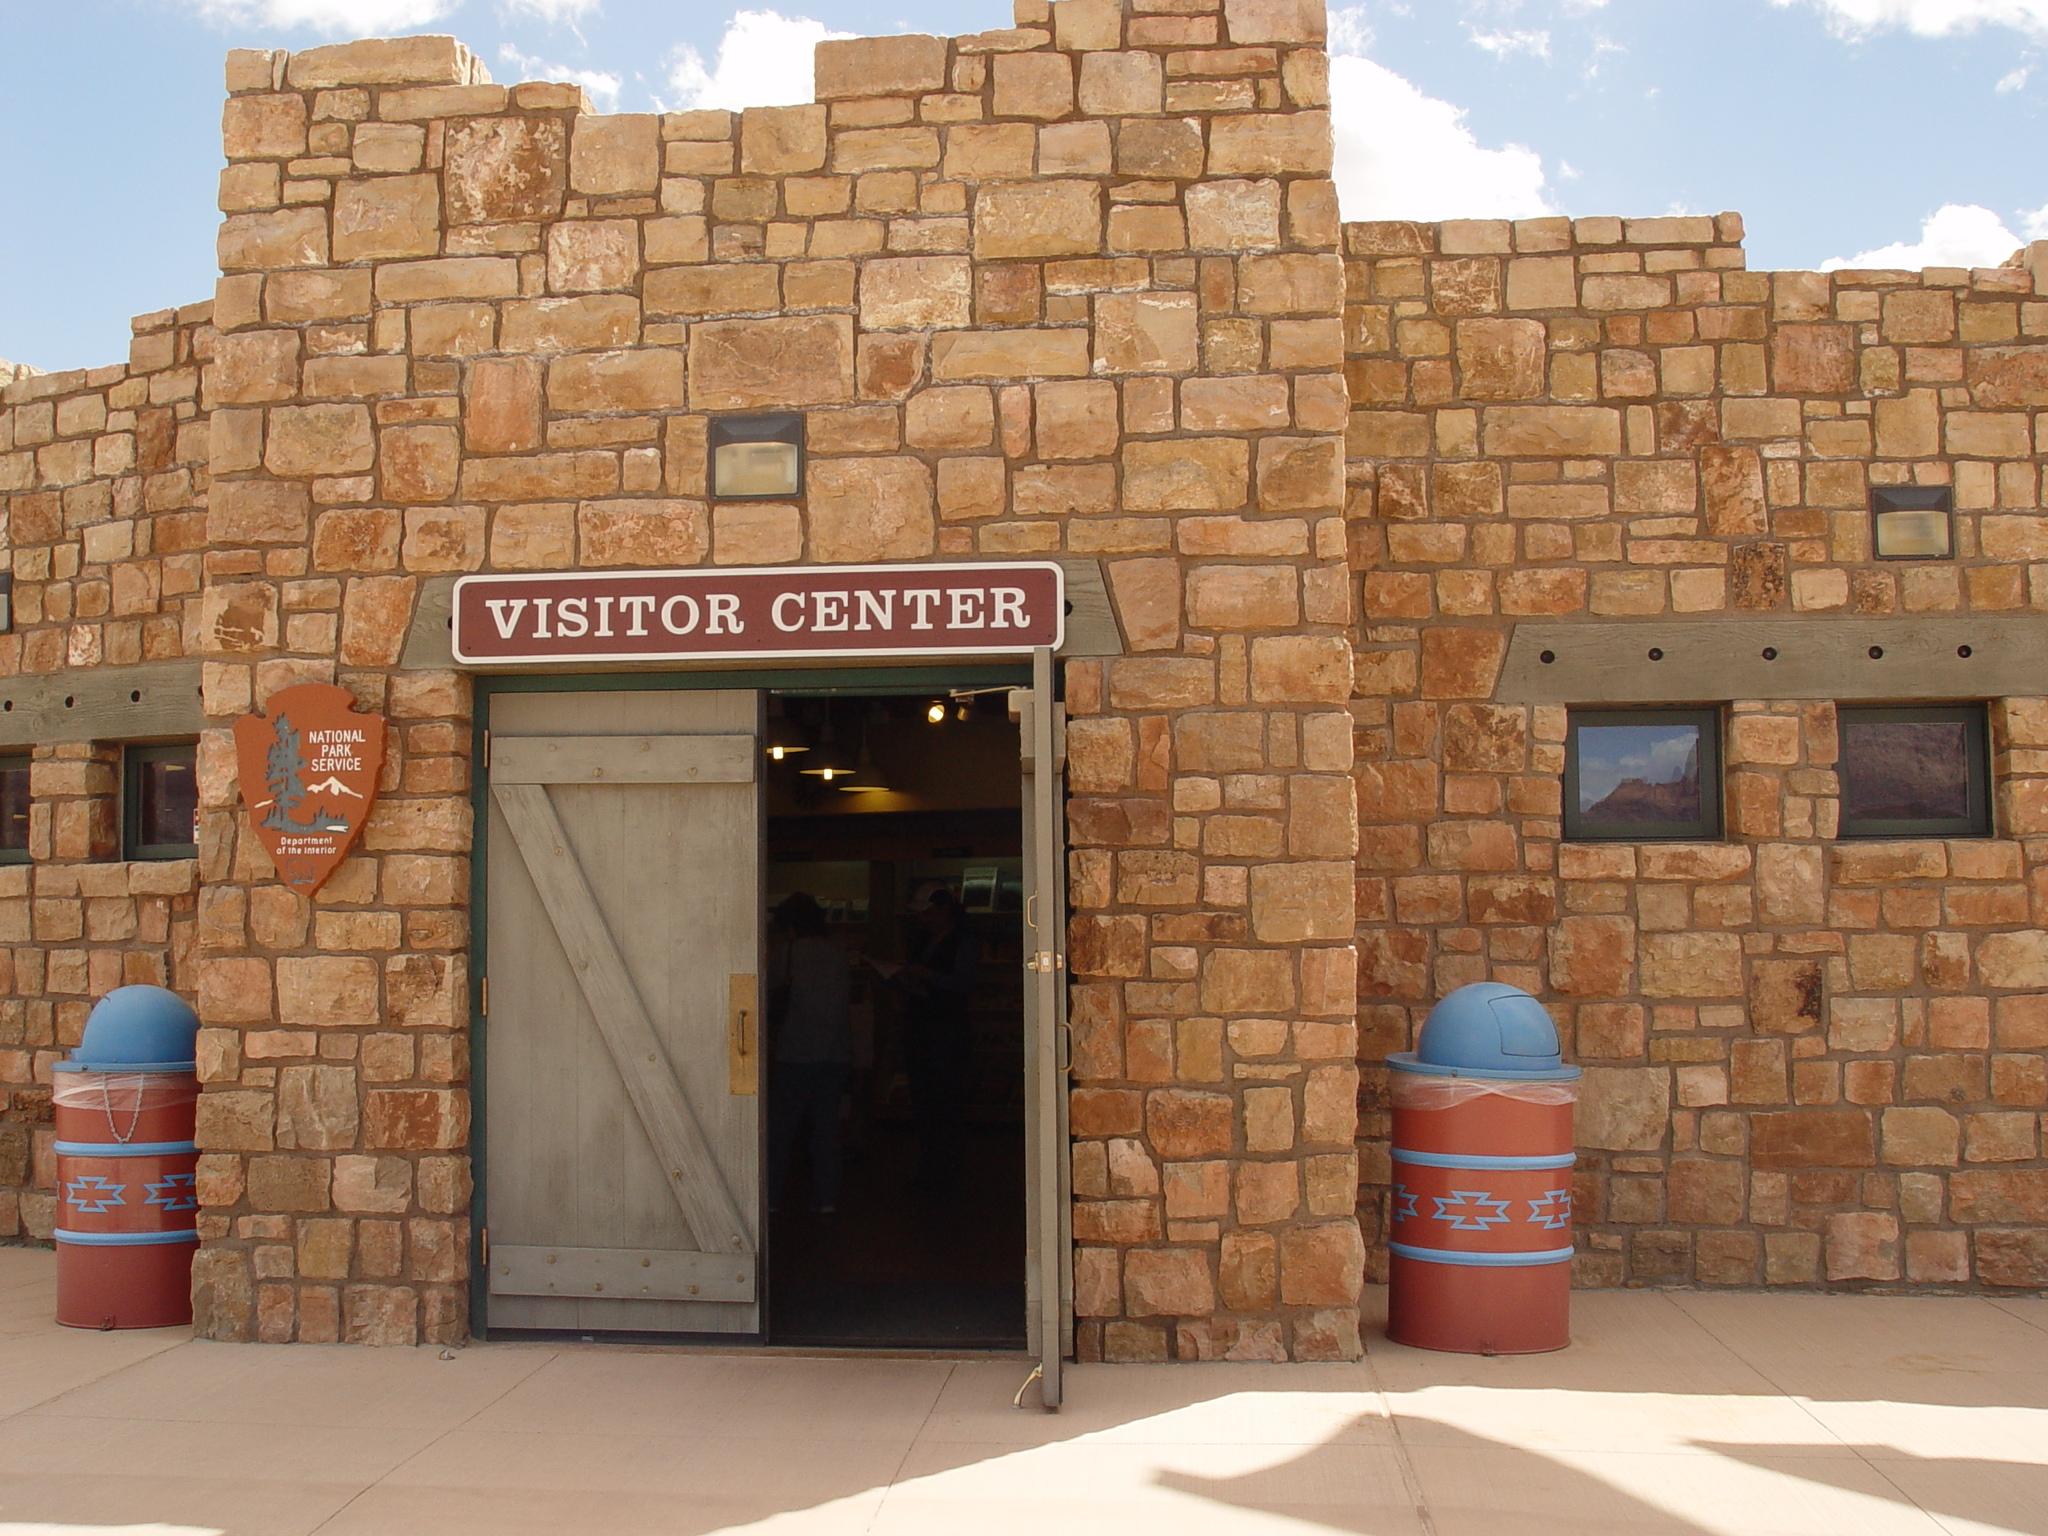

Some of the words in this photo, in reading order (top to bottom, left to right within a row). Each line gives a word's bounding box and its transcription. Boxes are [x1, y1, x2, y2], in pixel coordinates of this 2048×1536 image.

[485, 594, 745, 640] VISITOR
[770, 587, 1032, 633] CENTER
[309, 730, 366, 744] NATIONAL
[321, 744, 352, 757] PARK
[311, 758, 361, 771] SERVICE
[280, 836, 333, 846] Department
[276, 846, 286, 855] of
